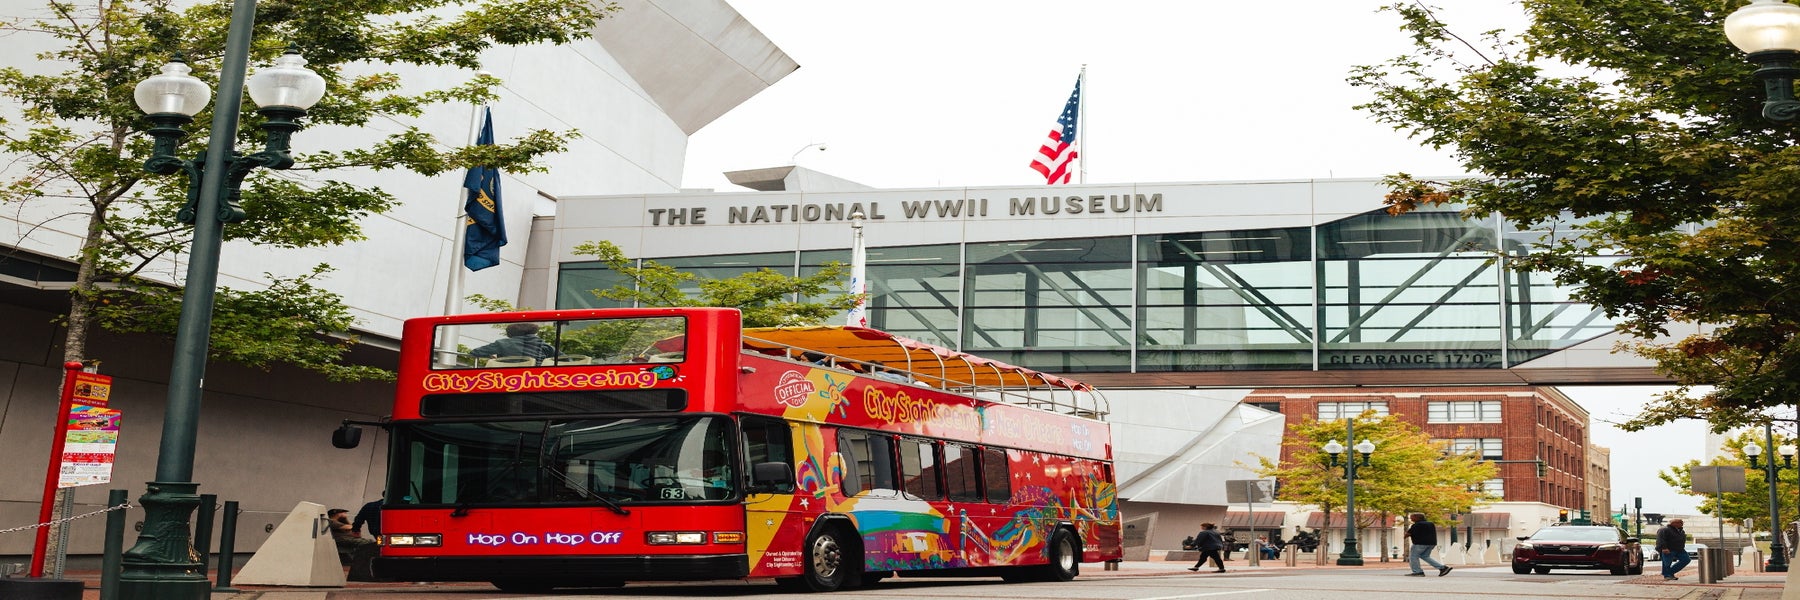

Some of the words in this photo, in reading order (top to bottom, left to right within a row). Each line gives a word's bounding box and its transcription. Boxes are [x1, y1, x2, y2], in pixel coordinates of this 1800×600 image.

[648, 207, 706, 225] THE
[728, 202, 885, 223] NATIONAL
[902, 198, 988, 218] WWII
[1009, 193, 1163, 215] MUSEUM
[1330, 354, 1435, 365] CLEARANCE
[423, 370, 658, 393] CitySightseeing
[779, 382, 813, 400] OFFICIAL
[791, 395, 806, 406] TOUR
[662, 488, 684, 499] 63
[468, 533, 506, 546] Hop
[512, 532, 538, 545] On
[546, 533, 585, 546] Hop
[590, 531, 622, 545] Off
